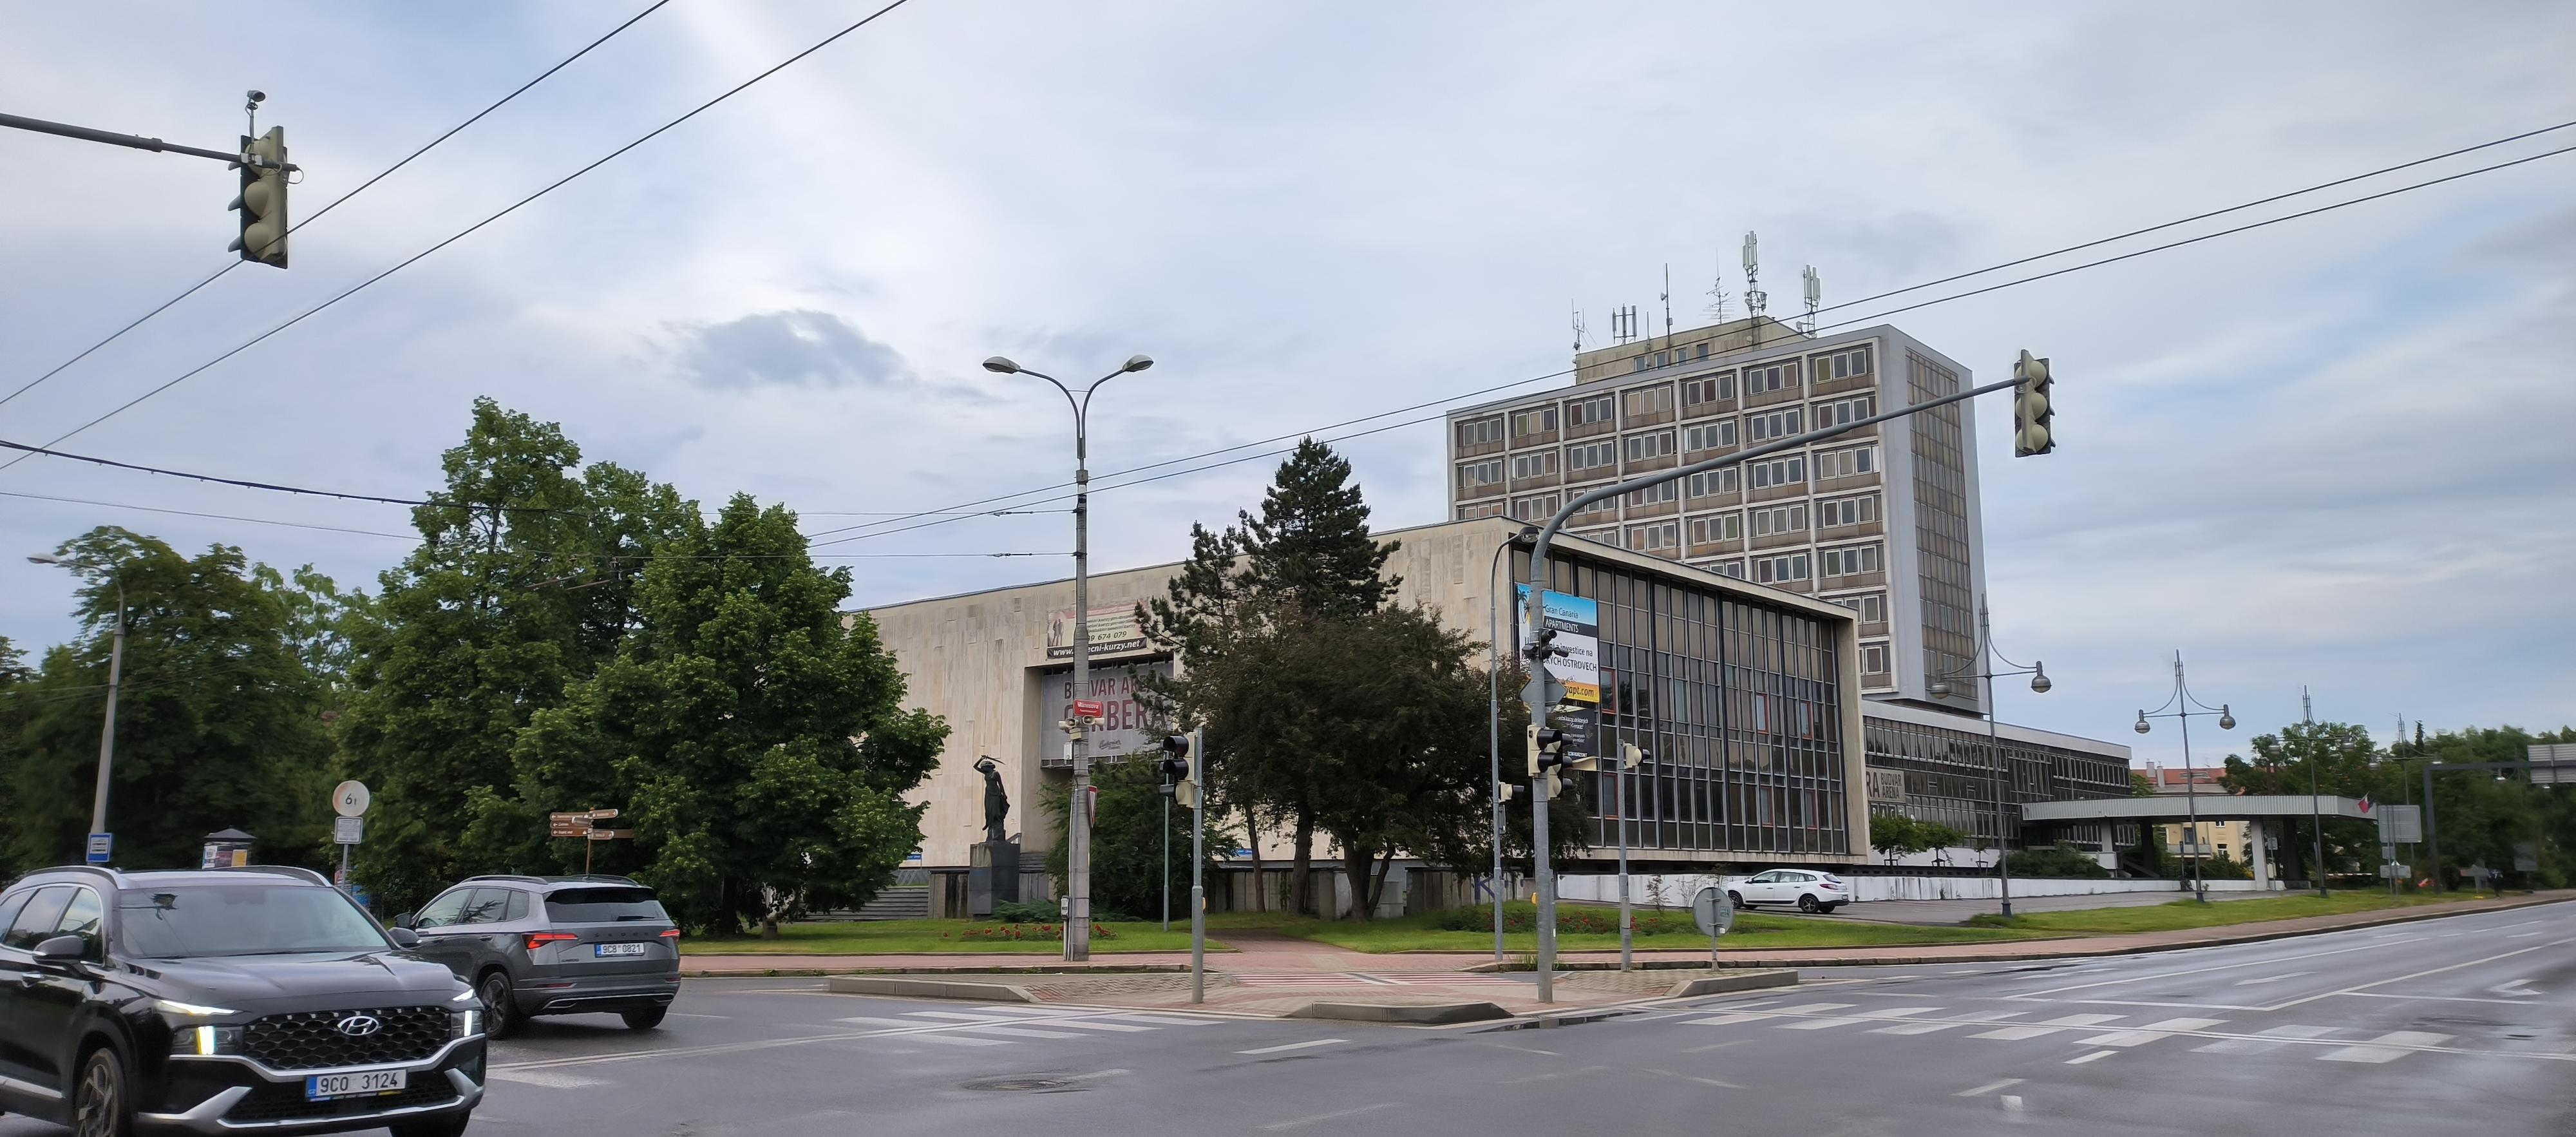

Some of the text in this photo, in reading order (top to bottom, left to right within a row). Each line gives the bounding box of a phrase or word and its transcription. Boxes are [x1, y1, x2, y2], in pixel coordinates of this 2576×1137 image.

[1545, 604, 1578, 619] Gran Canaria
[1545, 618, 1579, 633] APARTMENTS
[1562, 658, 1597, 672] OSTROVECH
[1064, 678, 1115, 699] BVAR
[1866, 770, 1880, 798] RA
[1880, 772, 1902, 787] BUDVAR
[1882, 786, 1900, 799] ARENA
[361, 1072, 398, 1090] 3124
